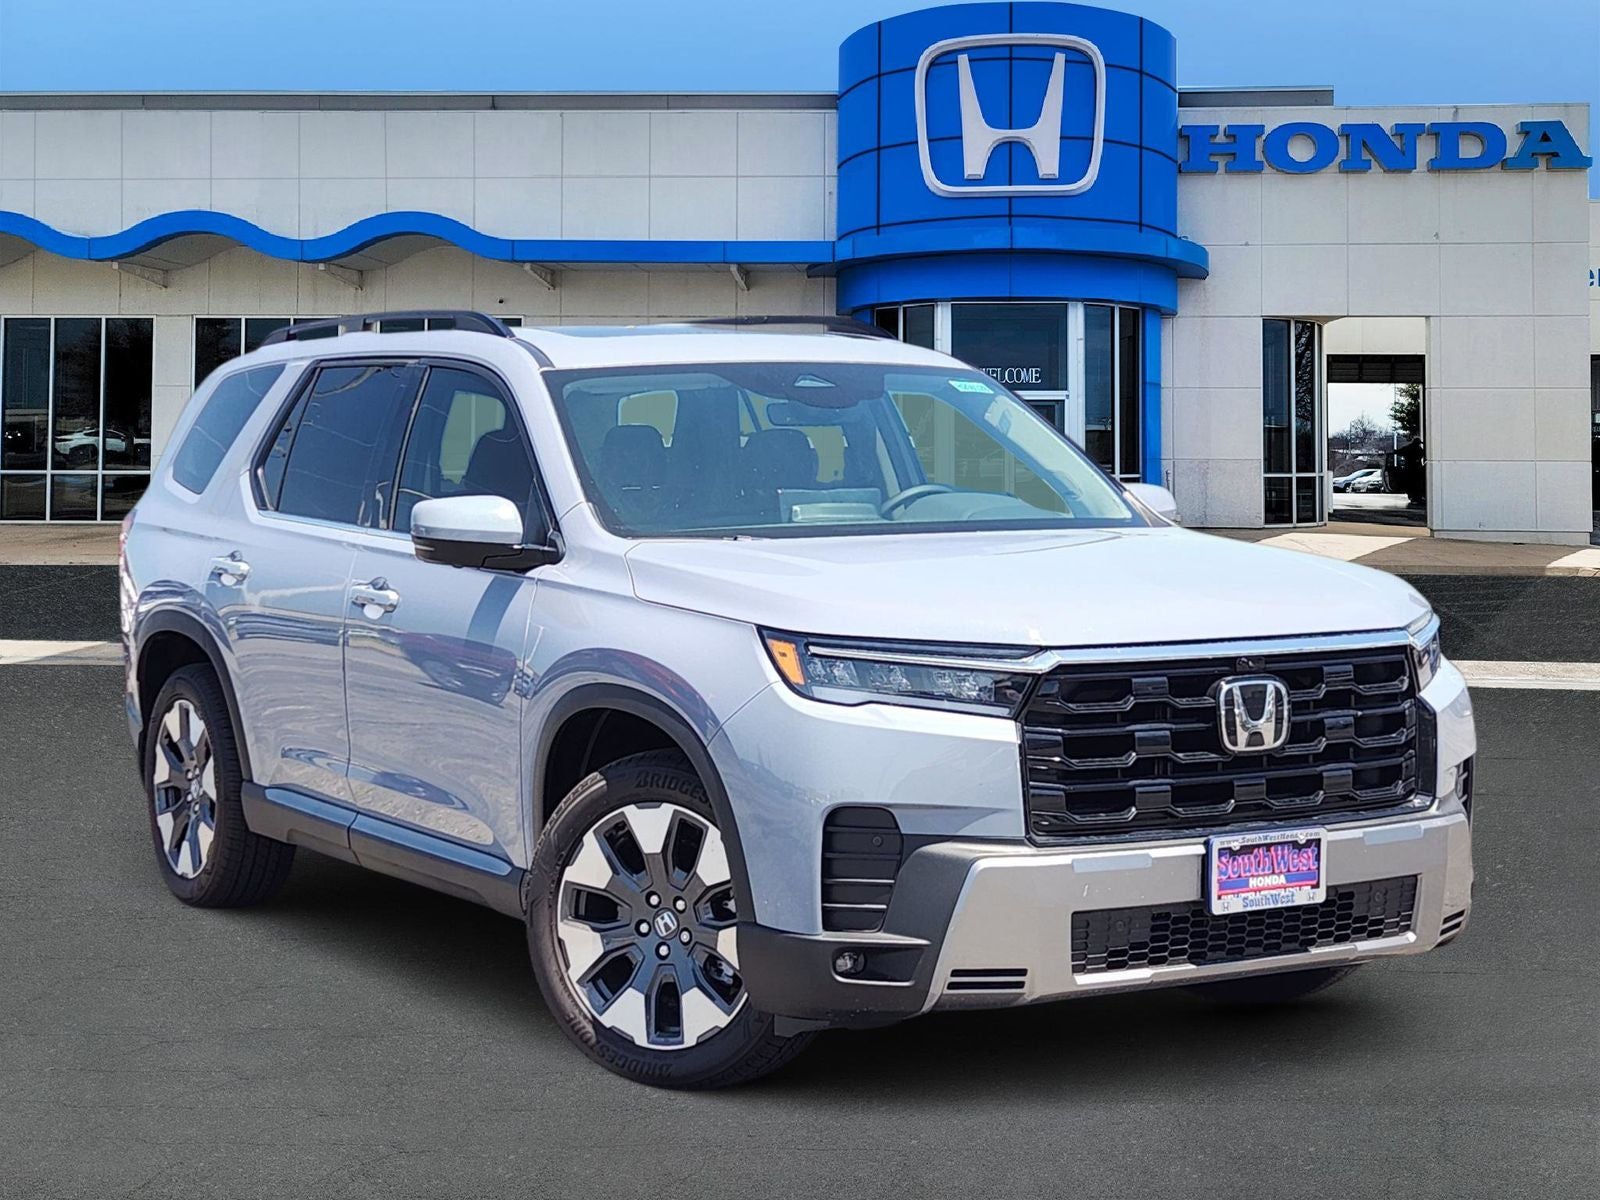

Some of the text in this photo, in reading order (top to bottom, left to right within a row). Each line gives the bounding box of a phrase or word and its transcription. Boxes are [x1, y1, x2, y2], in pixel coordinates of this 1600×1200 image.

[1179, 121, 1592, 174] HONDA
[634, 770, 710, 805] BRIDGES
[1217, 842, 1318, 880] SouthWest
[1248, 874, 1287, 888] HONDA
[1242, 890, 1295, 908] SouthWest
